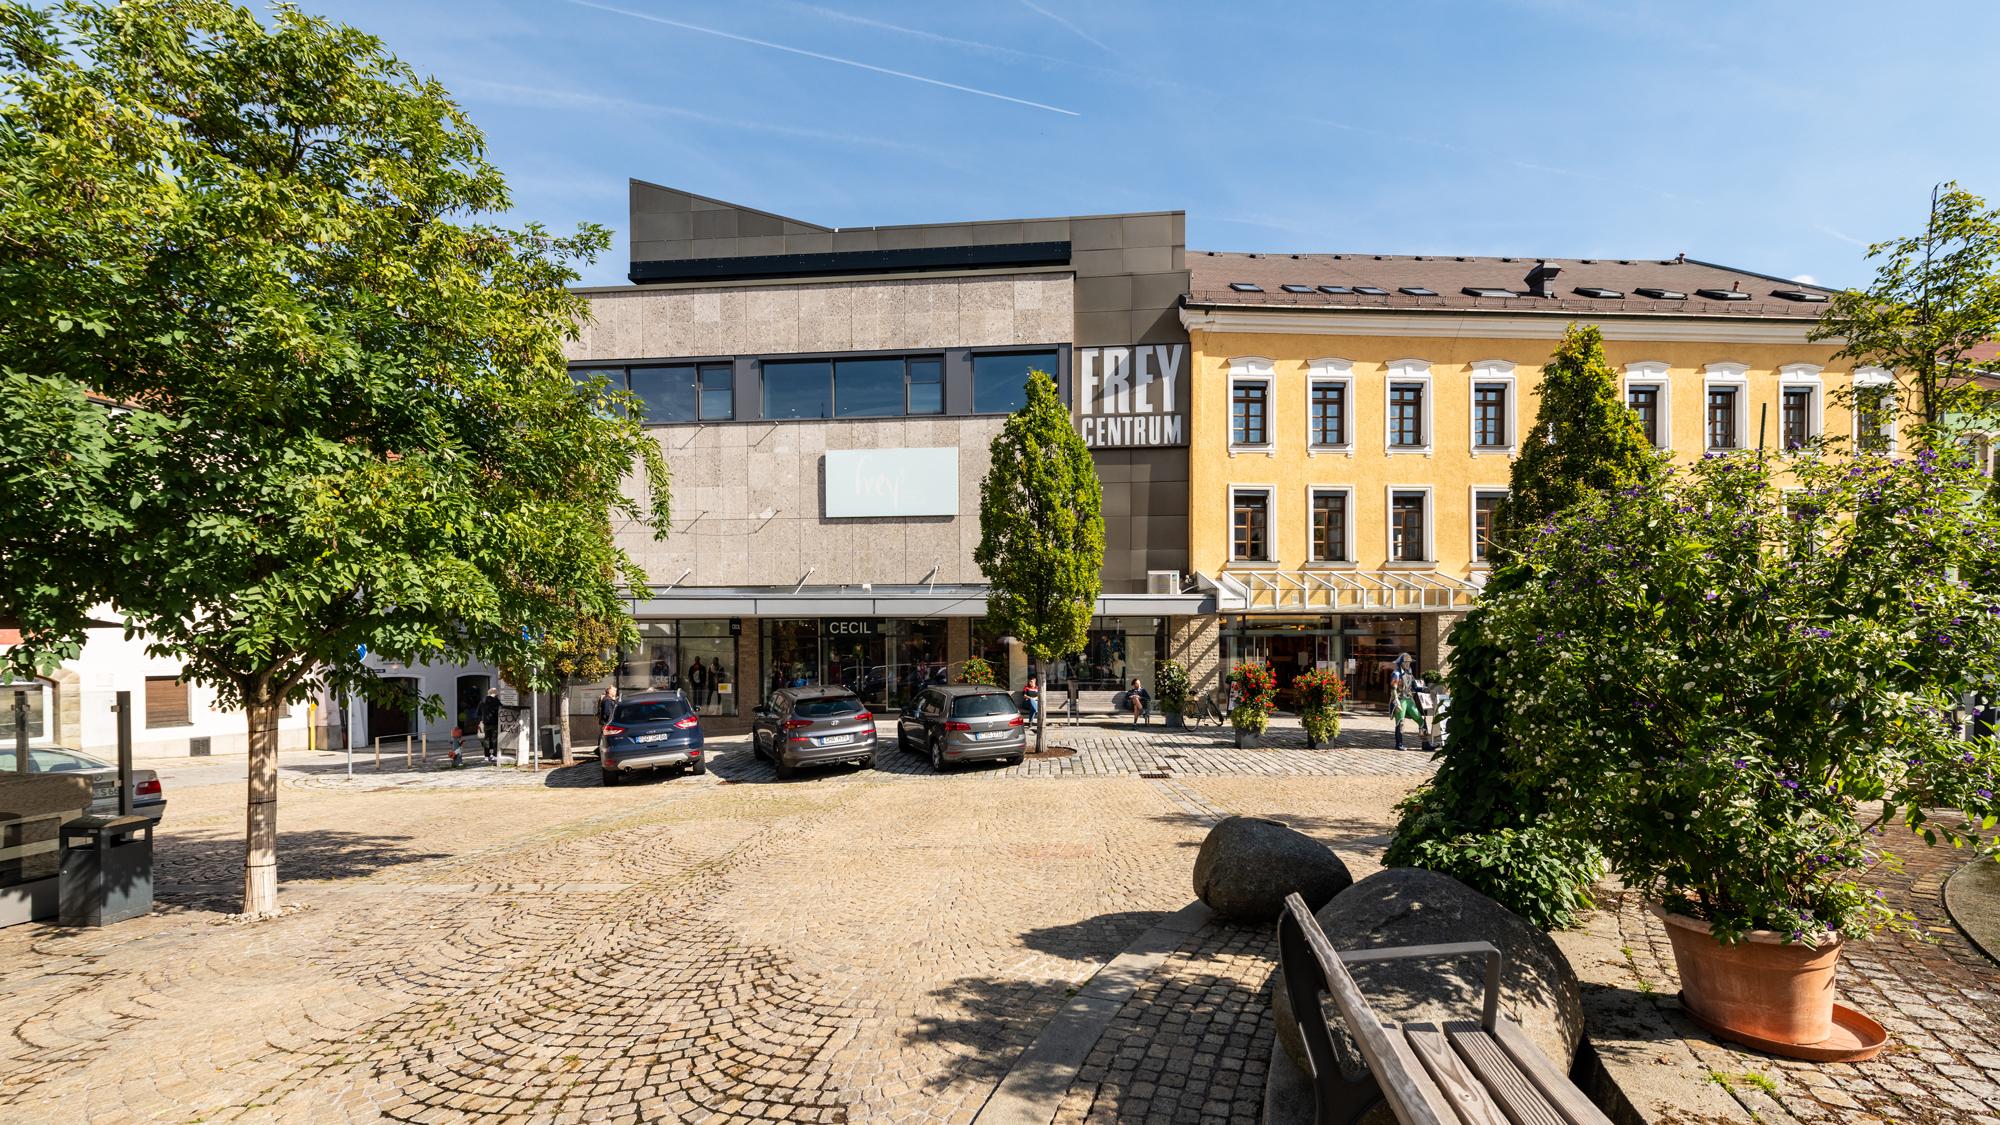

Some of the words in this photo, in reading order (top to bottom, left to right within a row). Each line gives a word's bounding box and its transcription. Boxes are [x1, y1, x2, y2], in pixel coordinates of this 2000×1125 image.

[1081, 344, 1184, 415] FREY
[1081, 415, 1182, 447] CENTRUM
[829, 621, 872, 634] CECIL
